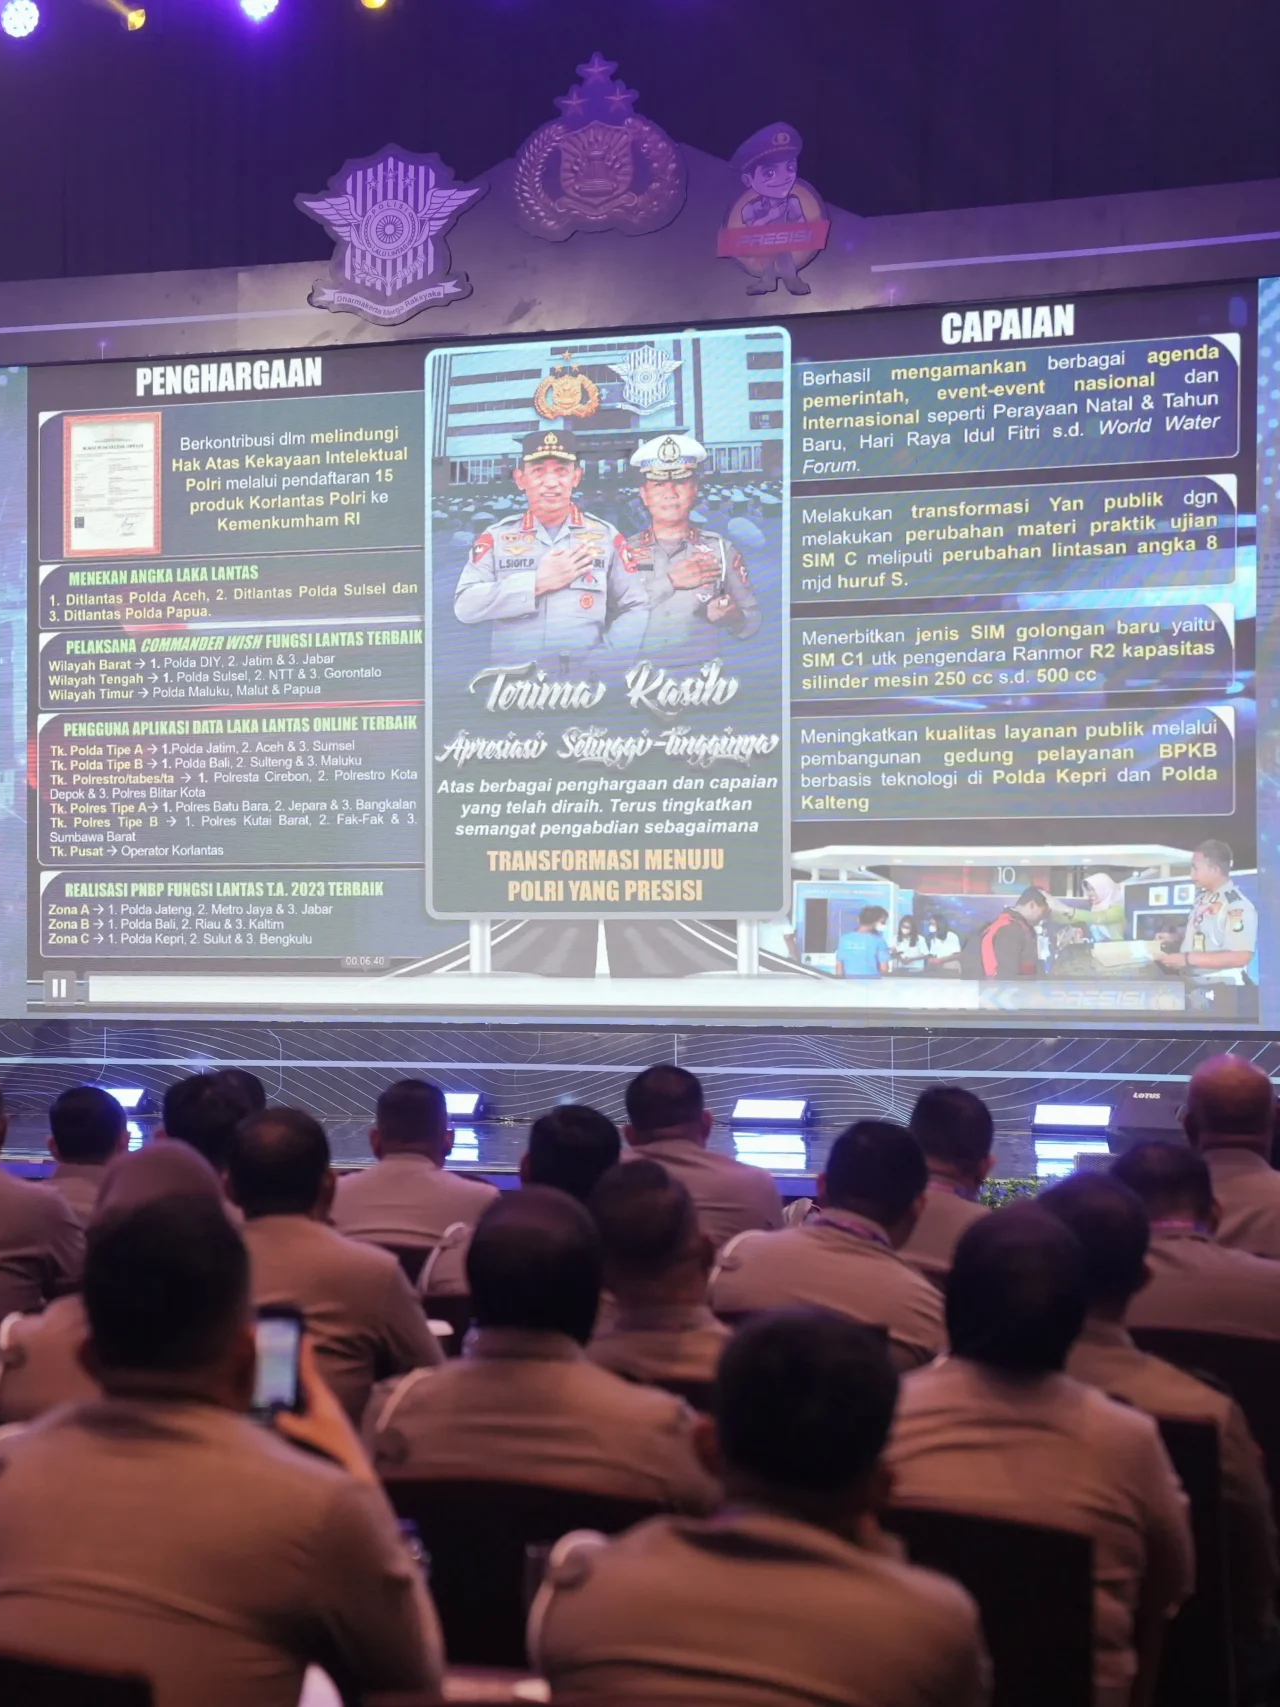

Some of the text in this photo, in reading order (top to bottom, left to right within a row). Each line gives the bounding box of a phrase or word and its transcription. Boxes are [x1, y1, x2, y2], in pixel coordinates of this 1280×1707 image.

[371, 202, 409, 214] POLISI
[736, 230, 812, 247] PRESISI
[940, 303, 1074, 345] CAPAIAN
[135, 356, 322, 396] PENGHARGAAN
[802, 343, 1219, 386] Berhasil mengamankan berbagai agenda
[802, 367, 1219, 412] pemerintah, event-event nasional dan
[802, 391, 1219, 430] Internasional seperti Perayaan Natal Tahun
[179, 424, 399, 451] Berkontribusi dlm melindungi
[802, 413, 1221, 452] Baru, Hari Raya Idul Fitri s.d. World Water
[171, 445, 407, 472] Hak Atas Kekayaan Intelektual
[801, 458, 861, 474] Forum.
[185, 467, 393, 492] Polri melalui pendaftaran 15
[189, 489, 389, 515] produk Korlantas Polri ke
[802, 489, 1218, 524] Melakukan transformasi Yan publik dgn
[217, 511, 360, 531] Kemenkumham RI
[801, 512, 1221, 546] melakukan perubahan materi praktik ujian
[801, 535, 1196, 568] SIM meliputi perubahan lintasan angka
[68, 564, 259, 586] MENEKAN ANGKA LAKA LANTAS
[65, 628, 423, 655] PELAKSANA COMMANDER WISH FUNGSI LANTAS TERBAIK
[47, 659, 96, 676] Wilayah
[98, 658, 132, 675] Barat
[163, 656, 197, 672] Polda
[241, 654, 273, 670] Jatim
[301, 652, 336, 669] Jabar
[47, 684, 96, 702] Wilayah
[98, 683, 135, 699] Timur
[152, 685, 185, 698] Polda
[236, 684, 269, 696] Malut
[283, 682, 321, 697] Papua
[467, 656, 739, 713] Terima Kasih
[434, 725, 780, 767] Apresiasi Setinggi-tingginya
[436, 773, 778, 796] Atas berbagai penghargaan dan capaian
[460, 796, 752, 818] yang telah diraih. Terus tingkatkan
[73, 816, 111, 828] Polres
[116, 813, 143, 830] Tipe
[201, 814, 237, 826] Polres
[243, 814, 272, 826] Kutai
[336, 812, 384, 825] Fak-Fak
[454, 818, 759, 838] semangat pengabdian sebagaimana
[69, 844, 104, 857] Pusat
[120, 844, 170, 859] Operator
[171, 844, 224, 856] Korlantas
[486, 847, 724, 871] TRANSFORMASI MENUJU
[64, 881, 384, 897] REALISASI PNBP FUNGSI LANTAS T.A. 2023 TERBAIK
[507, 879, 703, 901] POLRI YANG PRESISI
[47, 903, 78, 919] Zona
[79, 903, 90, 919] A
[120, 903, 153, 915] Polda
[210, 902, 244, 915] Metro
[245, 903, 273, 917] Jaya
[300, 902, 333, 914] Jabar
